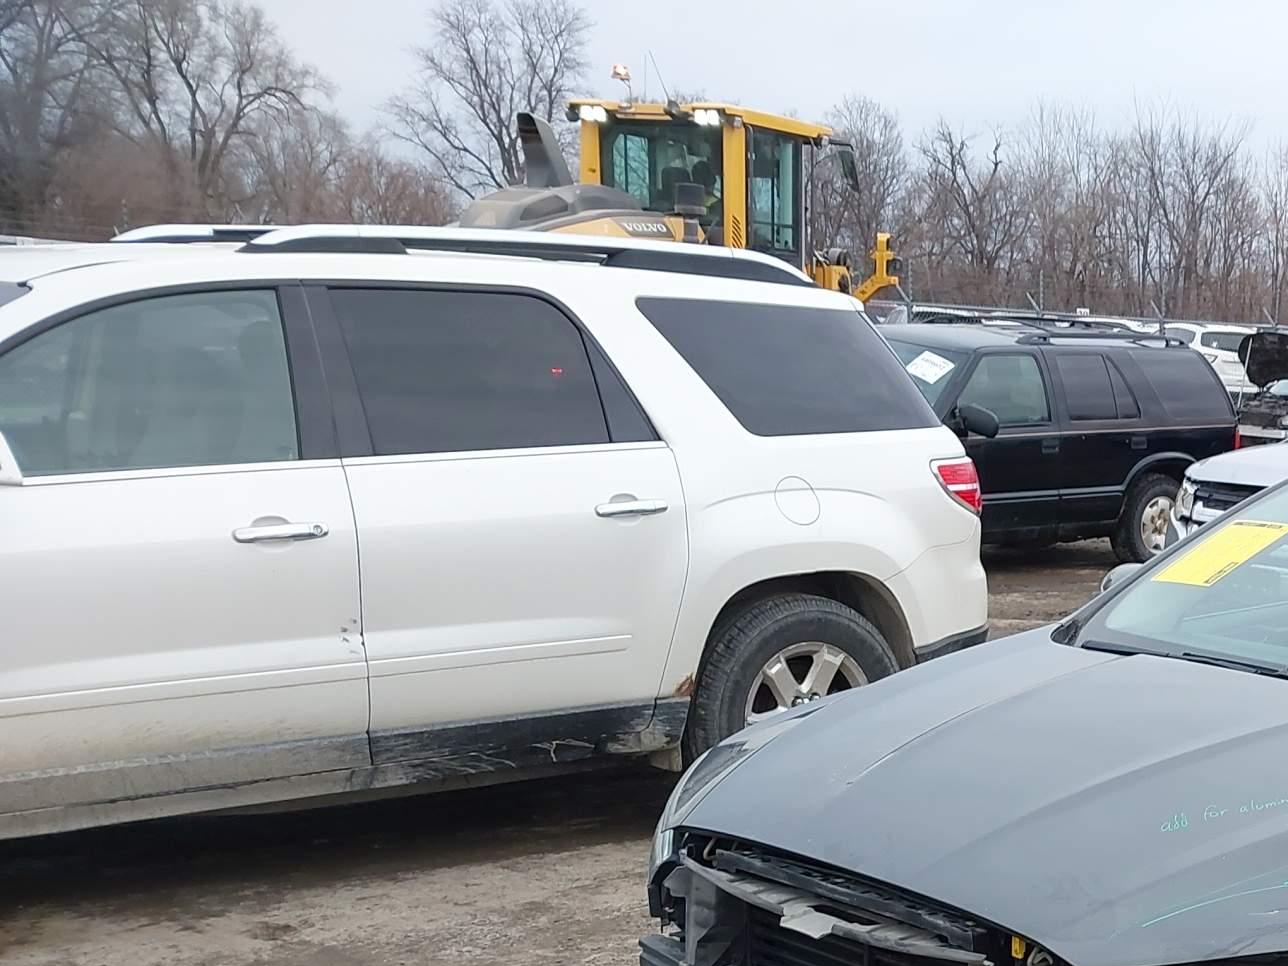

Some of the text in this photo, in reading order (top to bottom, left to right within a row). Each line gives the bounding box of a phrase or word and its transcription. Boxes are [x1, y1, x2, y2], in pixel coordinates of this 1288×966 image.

[622, 222, 668, 233] VOLVO
[1160, 812, 1189, 832] add
[1203, 805, 1229, 822] for
